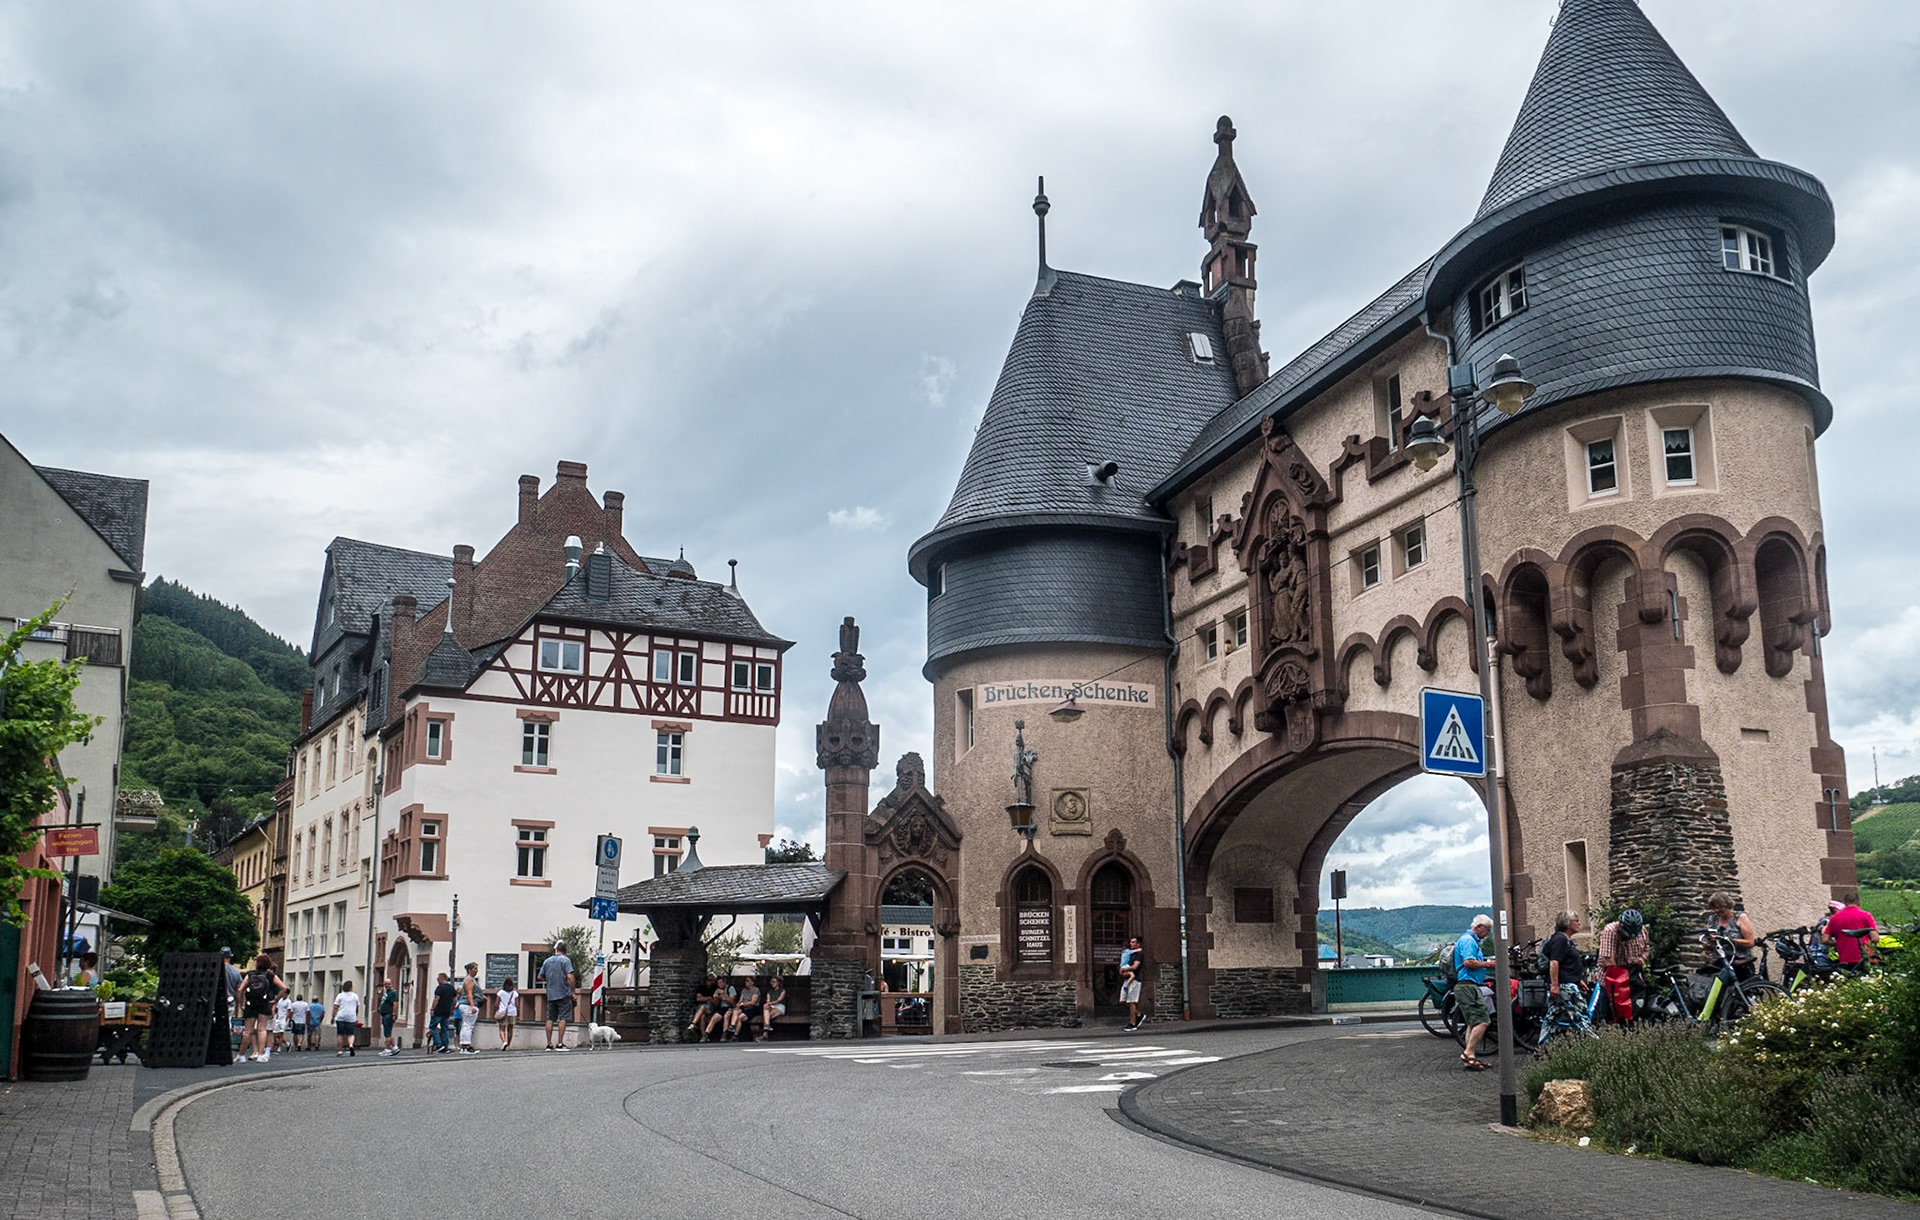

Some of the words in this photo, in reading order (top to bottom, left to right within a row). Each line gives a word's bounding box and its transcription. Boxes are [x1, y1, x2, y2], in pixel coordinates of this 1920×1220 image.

[51, 839, 94, 847] wohnungen
[900, 927, 931, 937] Bistro
[612, 941, 654, 955] PAN
